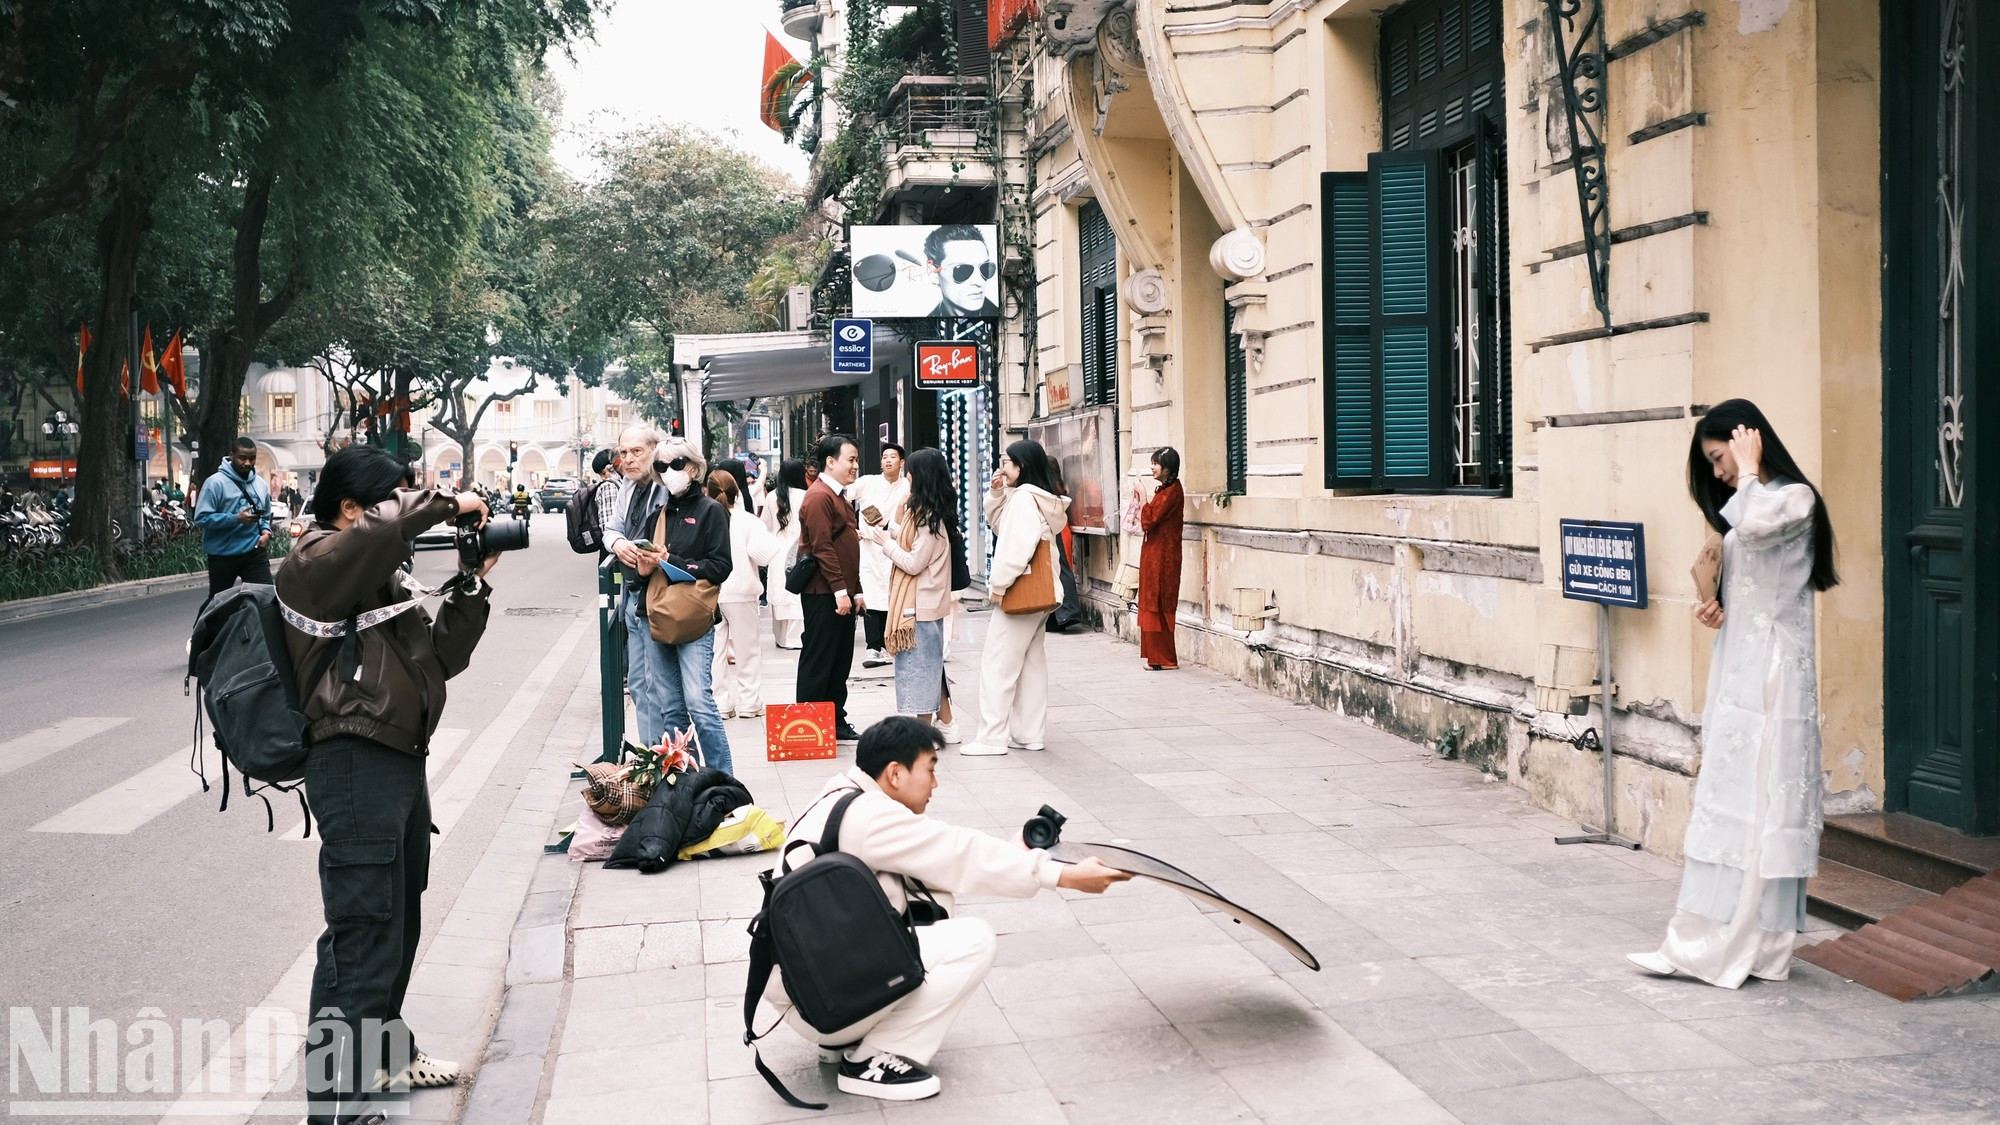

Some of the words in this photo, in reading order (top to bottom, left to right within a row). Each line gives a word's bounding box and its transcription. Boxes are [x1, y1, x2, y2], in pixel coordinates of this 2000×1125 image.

[839, 344, 866, 352] essilor
[923, 349, 973, 375] Ray-Ban
[1583, 565, 1593, 577] XE
[1594, 560, 1614, 579] CỔNG
[1616, 565, 1631, 581] BÊN
[1598, 580, 1617, 593] CÁCH
[1618, 585, 1632, 596] 10M
